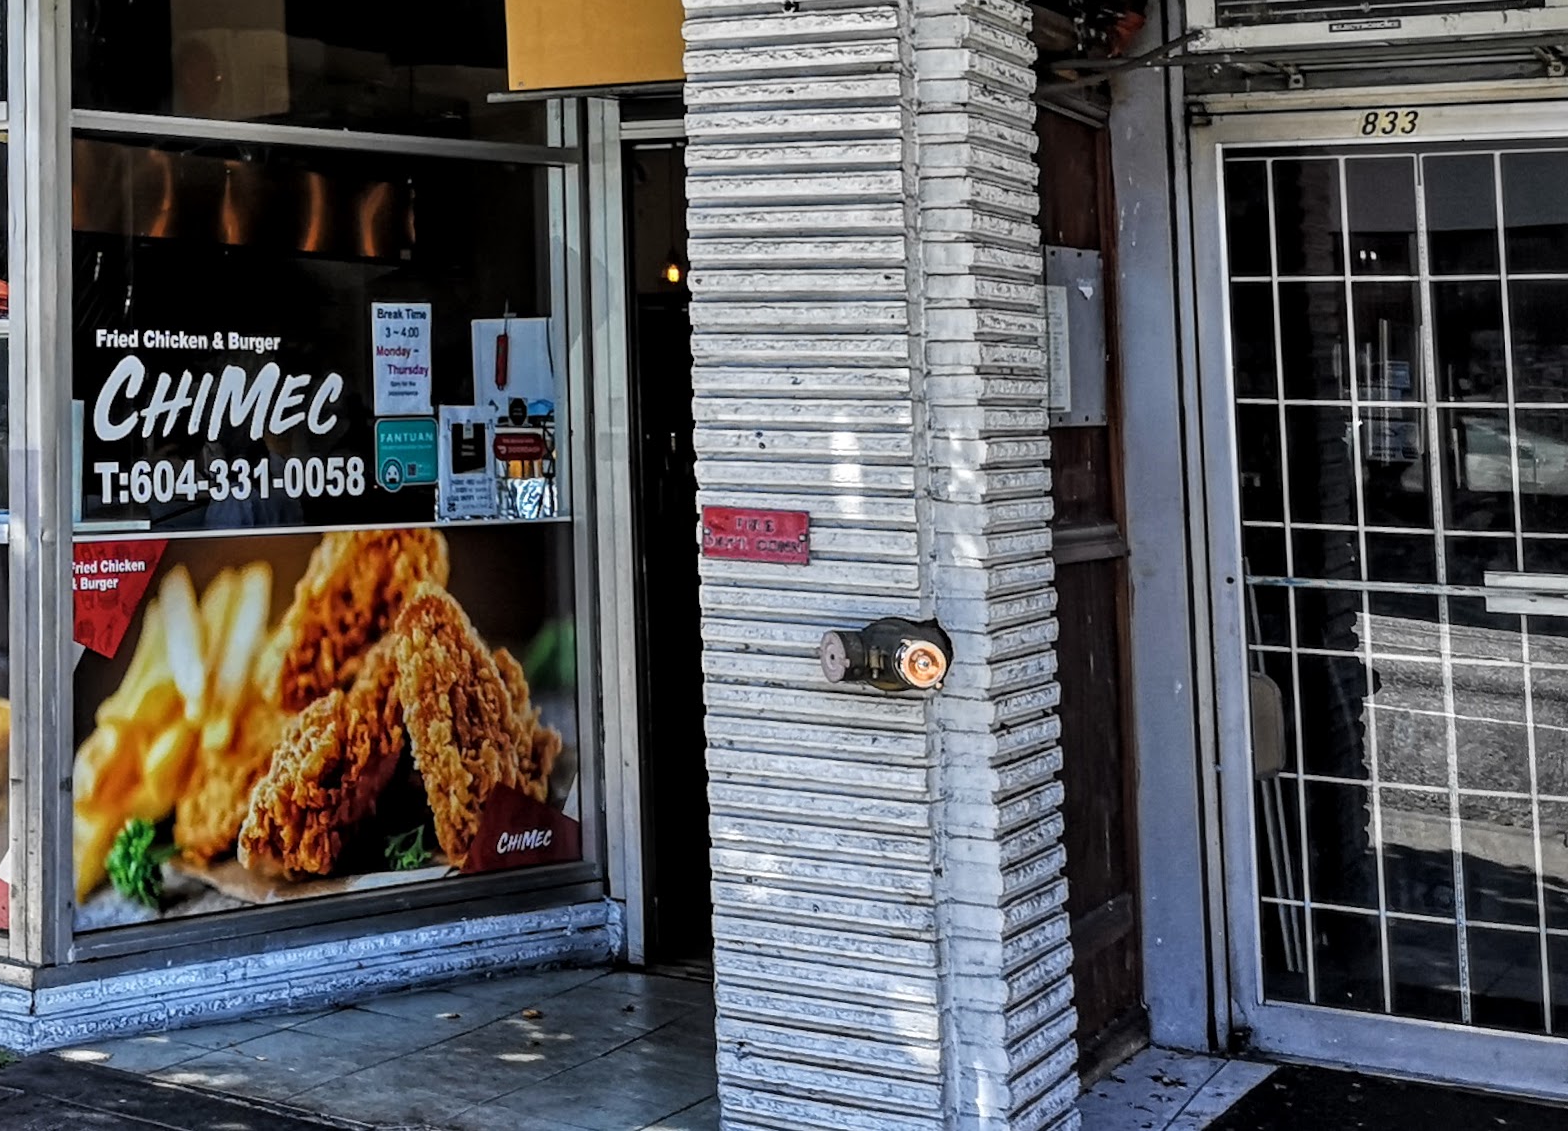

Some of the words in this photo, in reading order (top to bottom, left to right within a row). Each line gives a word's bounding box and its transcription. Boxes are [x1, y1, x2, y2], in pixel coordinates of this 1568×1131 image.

[1361, 110, 1419, 135] 833
[377, 308, 403, 319] Break
[405, 308, 427, 320] Time
[95, 329, 139, 349] Fried
[143, 330, 208, 350] Chicken
[212, 331, 225, 350] &
[228, 332, 281, 354] Burger
[376, 345, 412, 359] Monday
[387, 363, 430, 378] Thursday
[379, 432, 433, 443] FANTUAN
[93, 456, 365, 504] T:604-331-0058
[100, 558, 146, 573] Chicken
[80, 576, 119, 591] Burger
